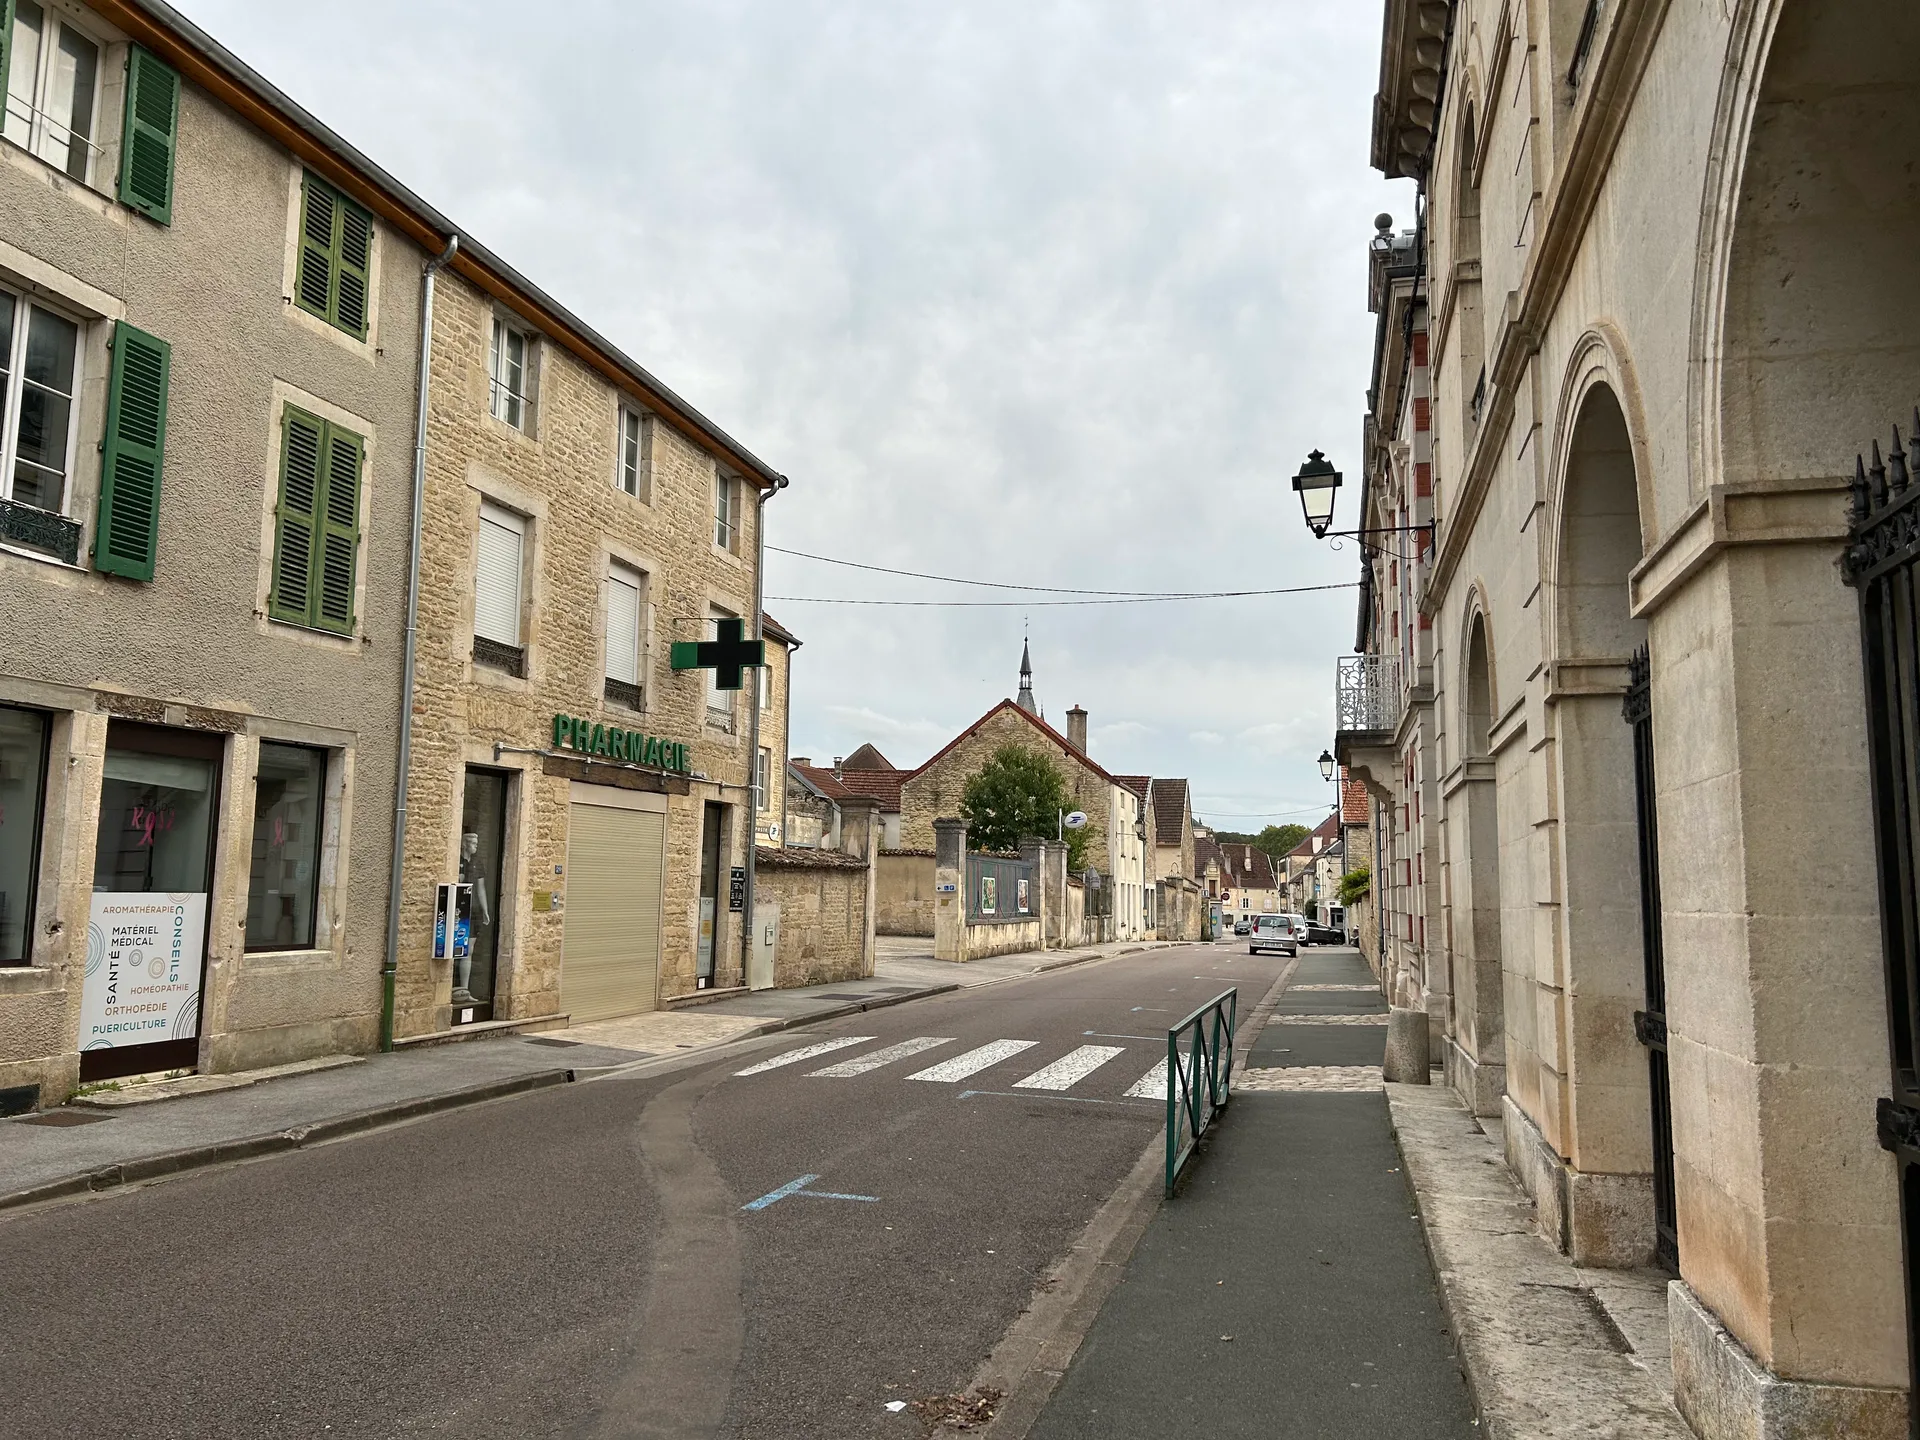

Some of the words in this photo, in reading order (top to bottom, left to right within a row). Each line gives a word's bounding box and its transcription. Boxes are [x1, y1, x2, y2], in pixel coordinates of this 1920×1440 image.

[553, 713, 692, 773] PHARMACIE
[103, 905, 175, 914] AROMATHÉRAPIE
[112, 924, 159, 936] MATÉRIEL
[436, 909, 446, 938] MANIX
[111, 936, 154, 947] MÉDICAL
[169, 905, 184, 982] CONSEILS
[106, 950, 120, 1004] SANTÉ
[130, 983, 190, 995] HOMÉOPATHIE
[104, 1002, 168, 1016] ORTHOPÉDIE
[92, 1018, 167, 1035] PUERICULTURE
